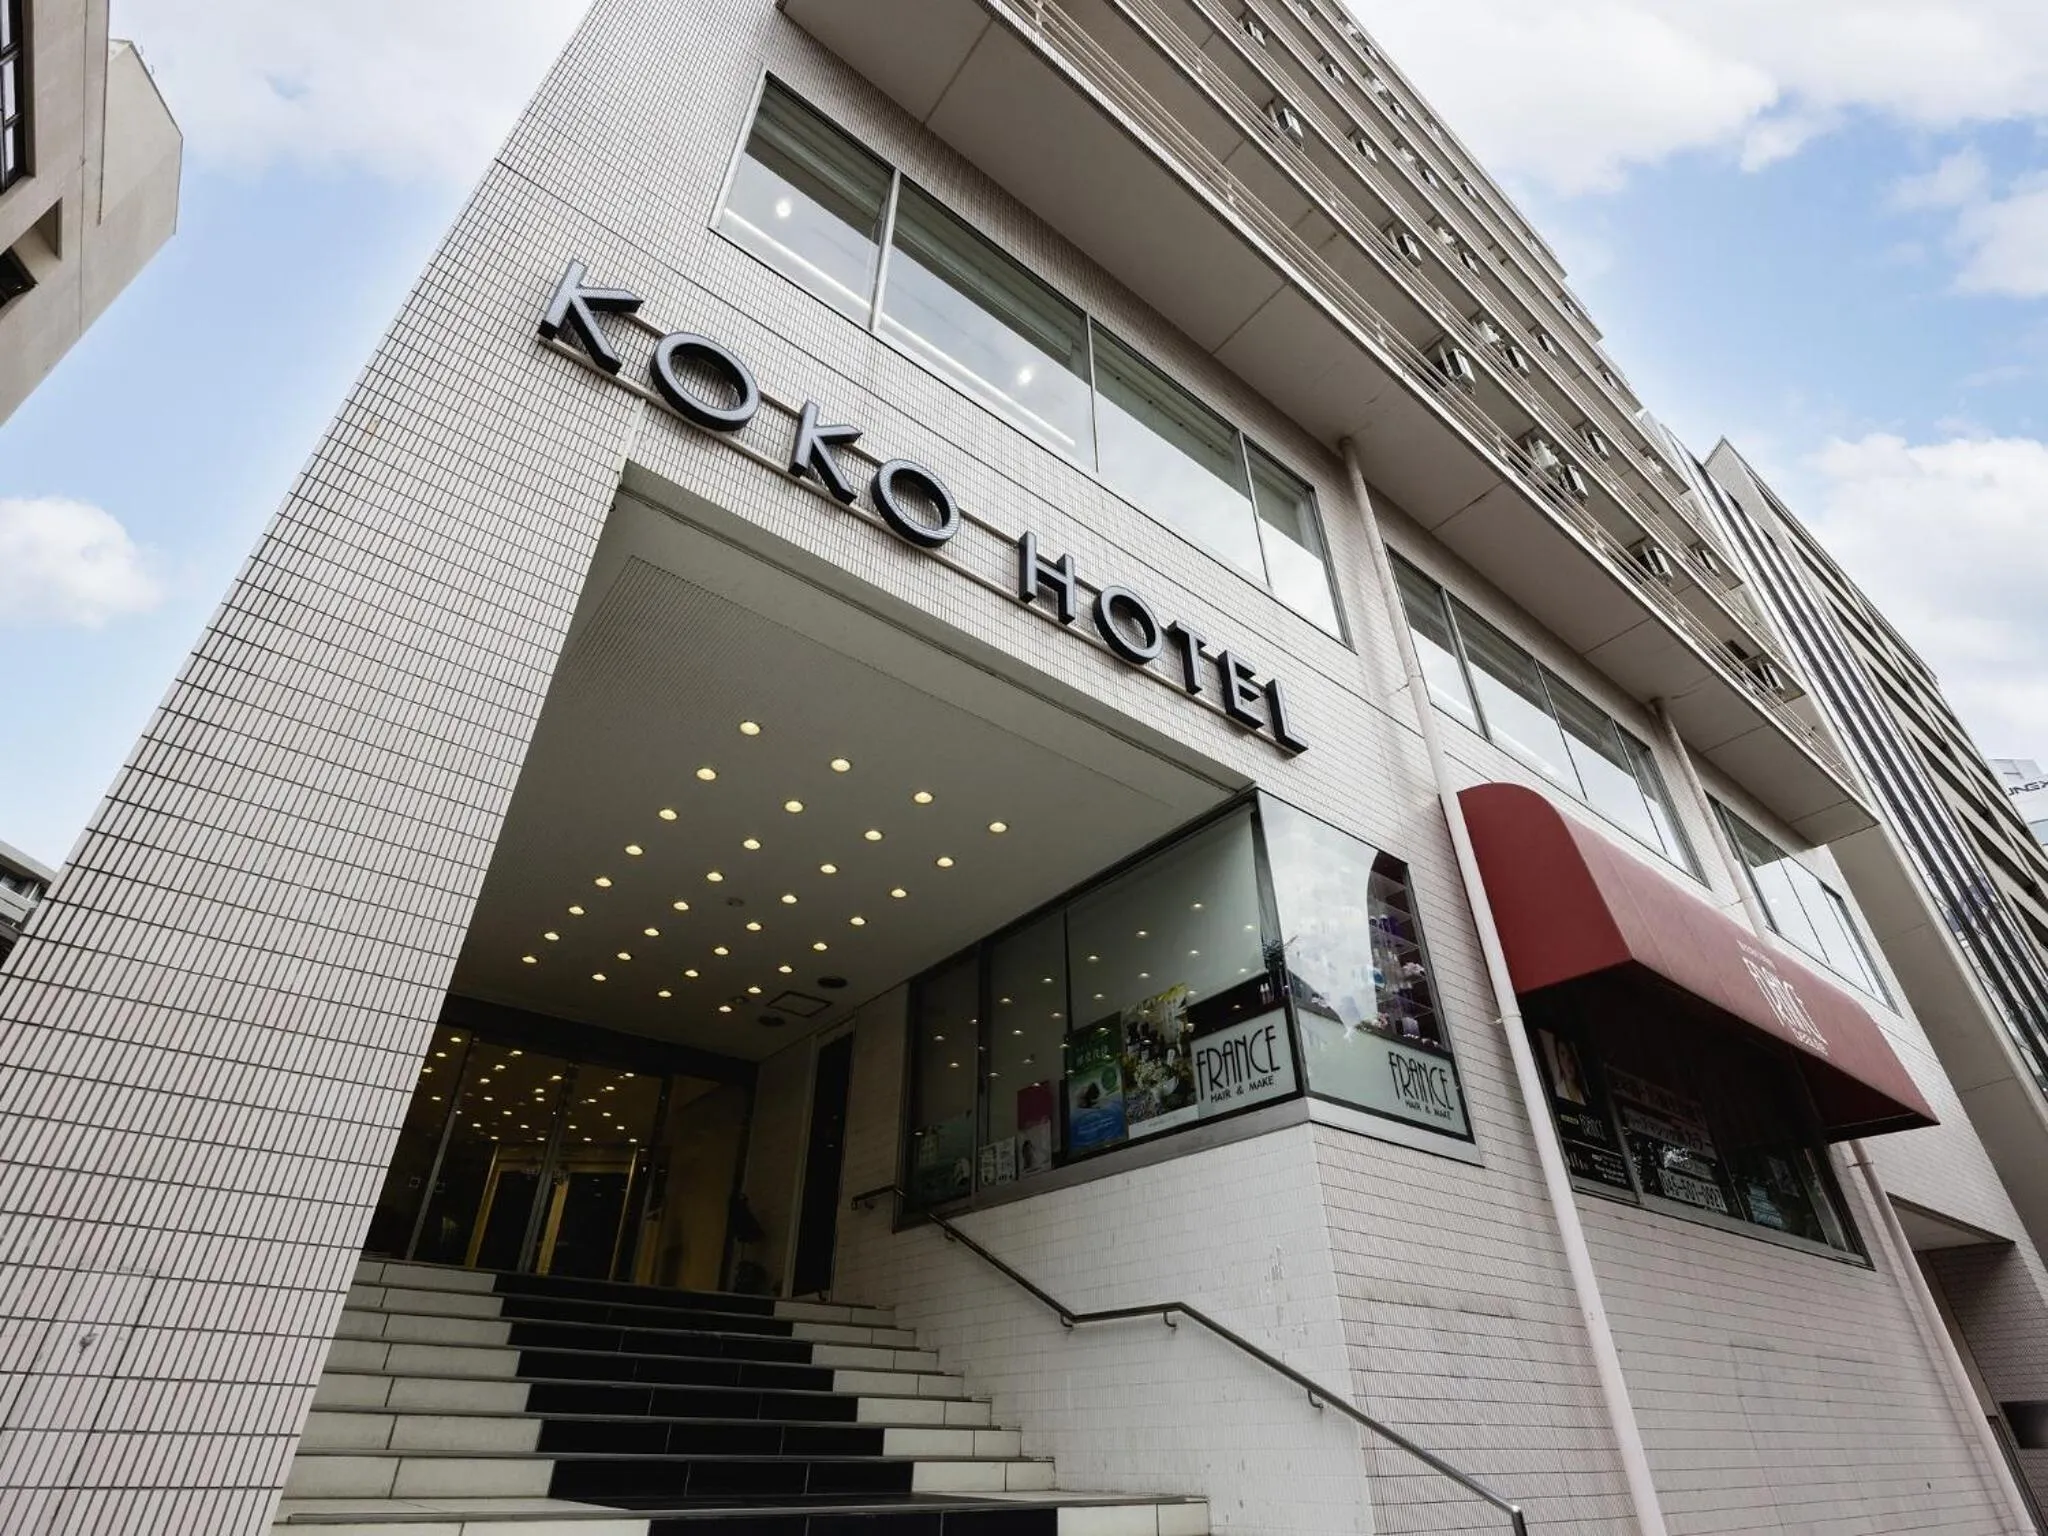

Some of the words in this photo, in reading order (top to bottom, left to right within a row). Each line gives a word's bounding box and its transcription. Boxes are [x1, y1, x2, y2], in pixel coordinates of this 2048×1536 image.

[1018, 530, 1309, 755] HOTEL
[1196, 1024, 1280, 1101] FRANCE
[1210, 1089, 1232, 1104] HAIR
[1236, 1085, 1245, 1095] &
[1249, 1075, 1274, 1091] MAKE
[1388, 1051, 1454, 1110] FRANCE
